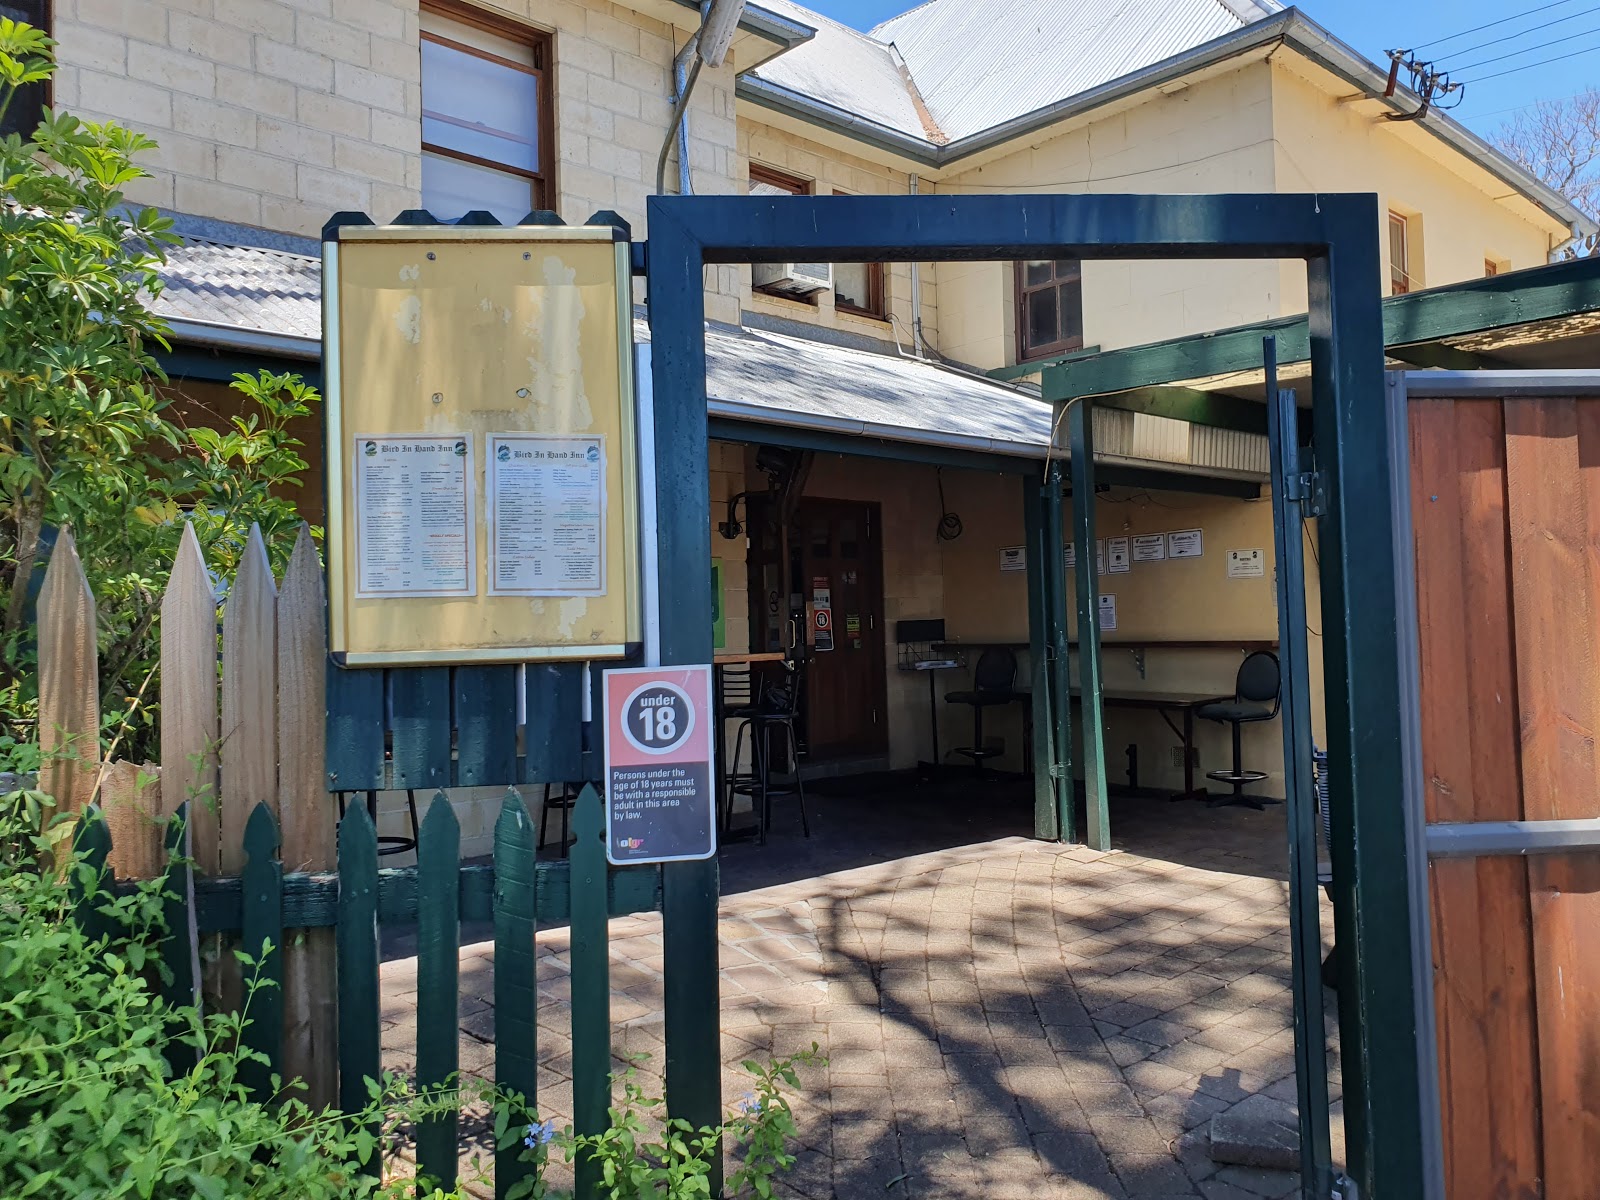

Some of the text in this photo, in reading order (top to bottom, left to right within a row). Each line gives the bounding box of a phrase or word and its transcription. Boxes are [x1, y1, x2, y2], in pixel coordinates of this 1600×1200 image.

[381, 444, 453, 453] Bird In Hand Inn
[514, 450, 585, 459] Bird In Hand Inn
[640, 694, 676, 707] under
[639, 707, 676, 741] 18
[613, 768, 685, 780] Persons under the
[613, 778, 695, 791] age of 18 years must
[613, 791, 624, 800] be
[625, 790, 644, 799] with
[652, 787, 696, 799] responsible
[614, 799, 680, 810] adult in this area
[614, 811, 642, 821] by law.
